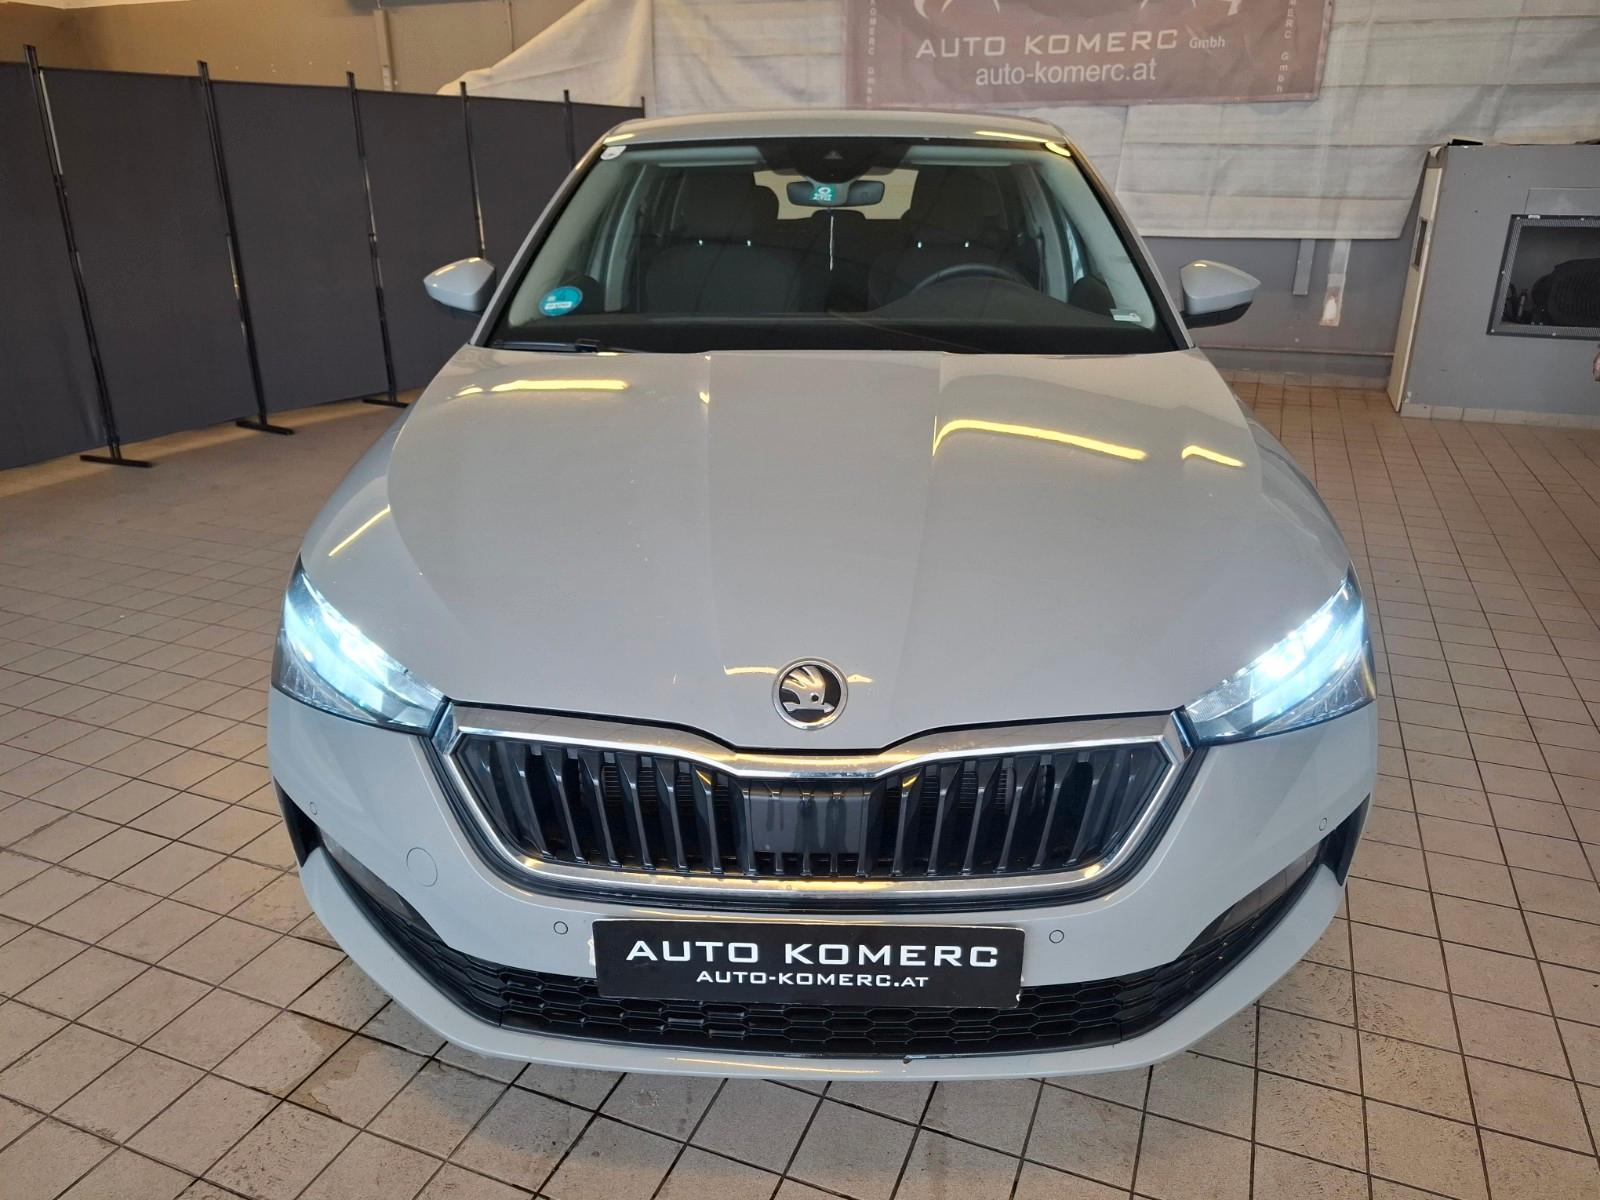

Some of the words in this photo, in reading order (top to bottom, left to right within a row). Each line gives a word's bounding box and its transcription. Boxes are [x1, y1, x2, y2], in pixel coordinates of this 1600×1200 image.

[915, 35, 1006, 59] AUTO
[1024, 28, 1178, 55] KOMERC
[1188, 35, 1226, 49] Gmbh
[975, 57, 1158, 86] auto-komerc.at
[1276, 51, 1289, 93] Gmbh
[625, 940, 759, 963] AUTO
[784, 942, 998, 968] KOMERC
[696, 970, 929, 988] AUTO-KOMERC.AT
